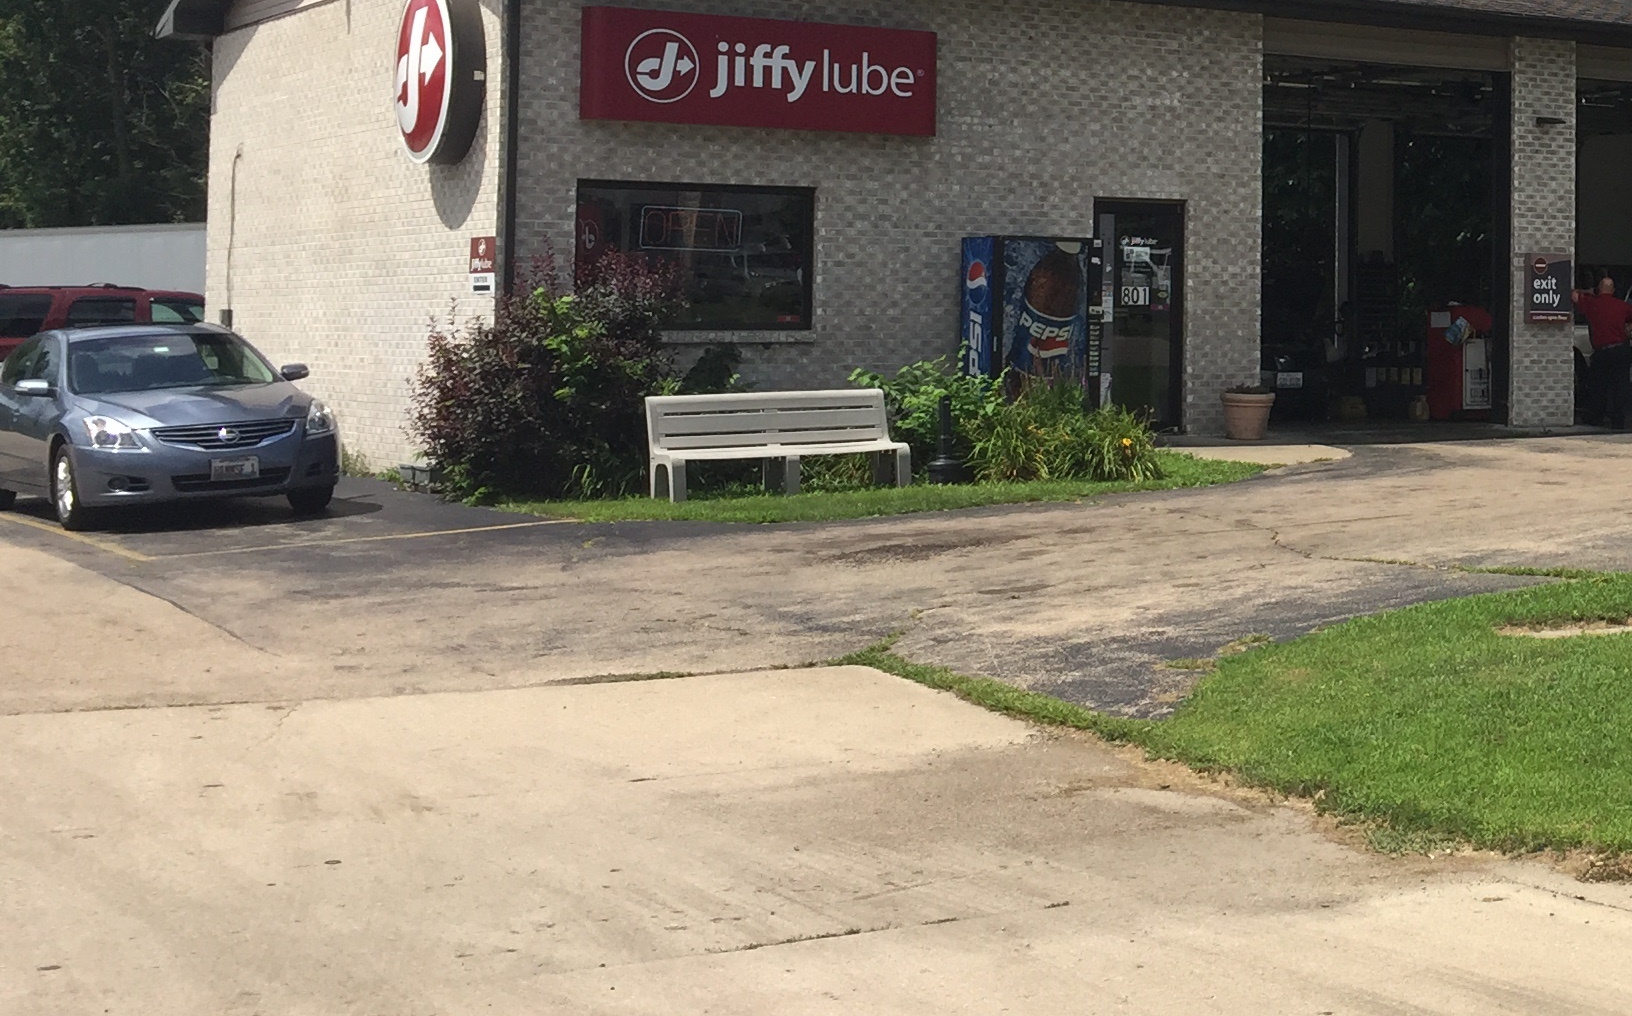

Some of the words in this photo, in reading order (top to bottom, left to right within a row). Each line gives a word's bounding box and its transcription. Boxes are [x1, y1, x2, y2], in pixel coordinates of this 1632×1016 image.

[1533, 275, 1557, 290] exit
[1122, 287, 1148, 305] 801
[1533, 290, 1561, 307] only
[1019, 311, 1075, 342] PEPSI
[968, 310, 983, 377] PSI
